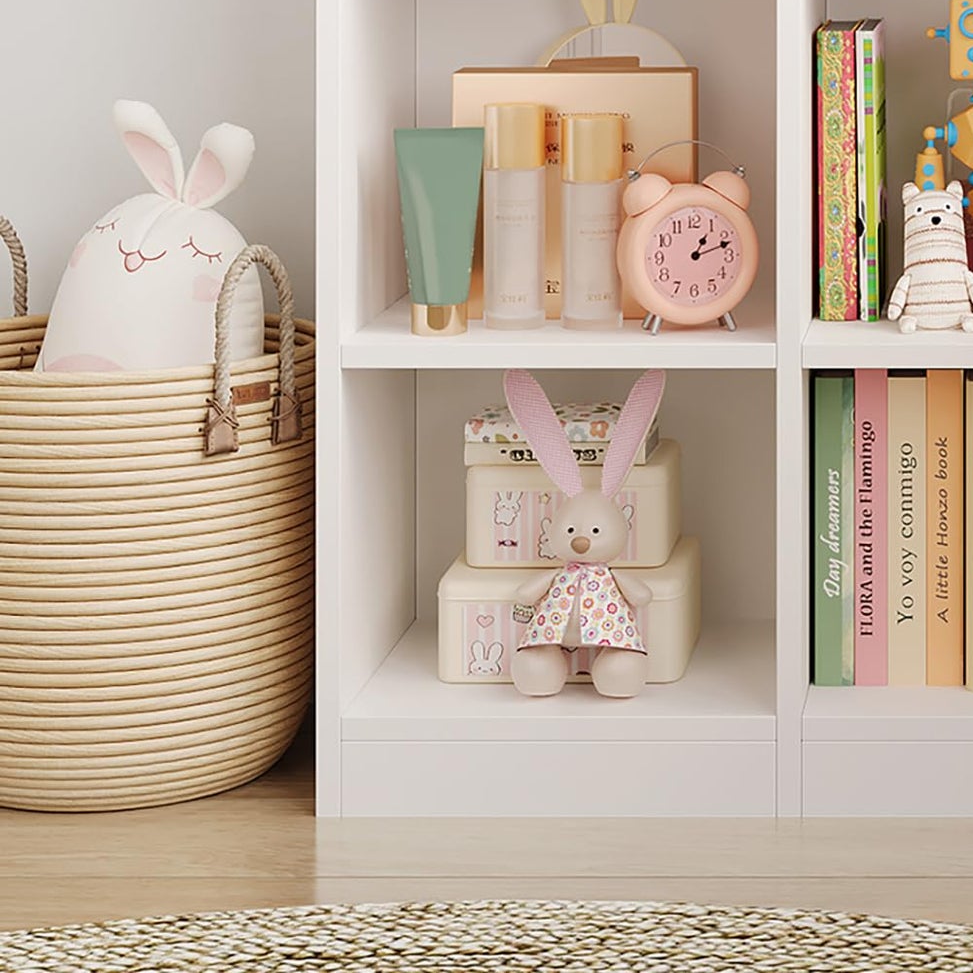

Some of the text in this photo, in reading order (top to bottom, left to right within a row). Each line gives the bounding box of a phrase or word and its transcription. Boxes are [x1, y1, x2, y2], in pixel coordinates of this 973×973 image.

[672, 219, 682, 235] 11
[687, 213, 701, 230] 12
[708, 218, 714, 232] 1
[659, 232, 672, 248] 10
[654, 250, 664, 267] 9
[723, 247, 735, 263] 3
[658, 267, 670, 282] 8
[717, 266, 726, 279] 4
[674, 281, 681, 294] 7
[689, 283, 700, 298] 6
[708, 278, 718, 293] 5
[820, 469, 848, 599] Day dreamers
[857, 421, 875, 635] FLORA and the Flamingo
[897, 443, 917, 623] Yo voy conmigo
[935, 437, 948, 623] A little Honzo book
